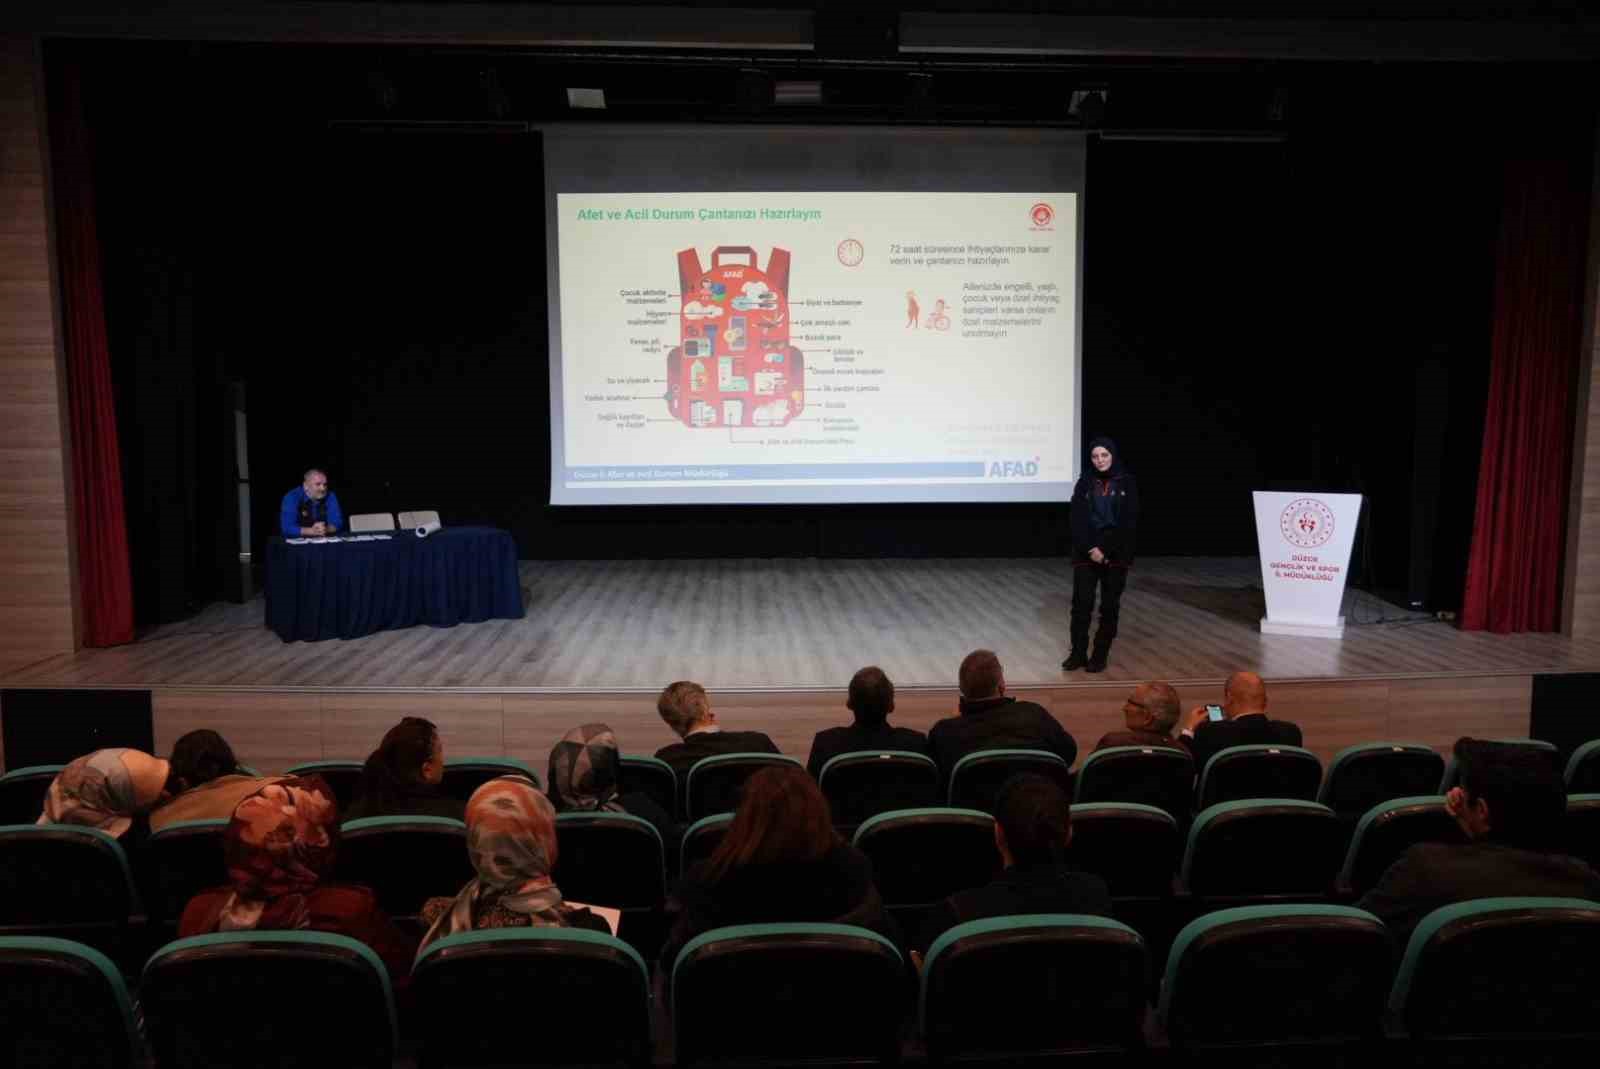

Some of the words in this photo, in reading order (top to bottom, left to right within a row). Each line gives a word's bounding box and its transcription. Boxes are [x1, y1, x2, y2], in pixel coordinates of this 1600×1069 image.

[577, 208, 603, 220] Afet
[607, 210, 621, 220] ve
[625, 208, 648, 220] Acil
[652, 208, 694, 220] Durum
[699, 207, 755, 222] Çantanızı
[760, 207, 821, 222] Hazırlayın
[889, 244, 900, 254] 72
[903, 245, 922, 254] saat
[924, 244, 965, 254] süresince
[889, 256, 911, 265] verin
[963, 282, 1002, 291] Ailenizde
[620, 289, 640, 297] Çocuk
[962, 294, 987, 304] çocuk
[990, 296, 1011, 304] veya
[1013, 294, 1031, 302] özel
[1033, 294, 1060, 304] ihtiyaç
[962, 318, 981, 326] özel
[990, 461, 1039, 477] AFAD
[1291, 554, 1319, 562] DÜZCE
[1270, 562, 1304, 571] GENÇLİK
